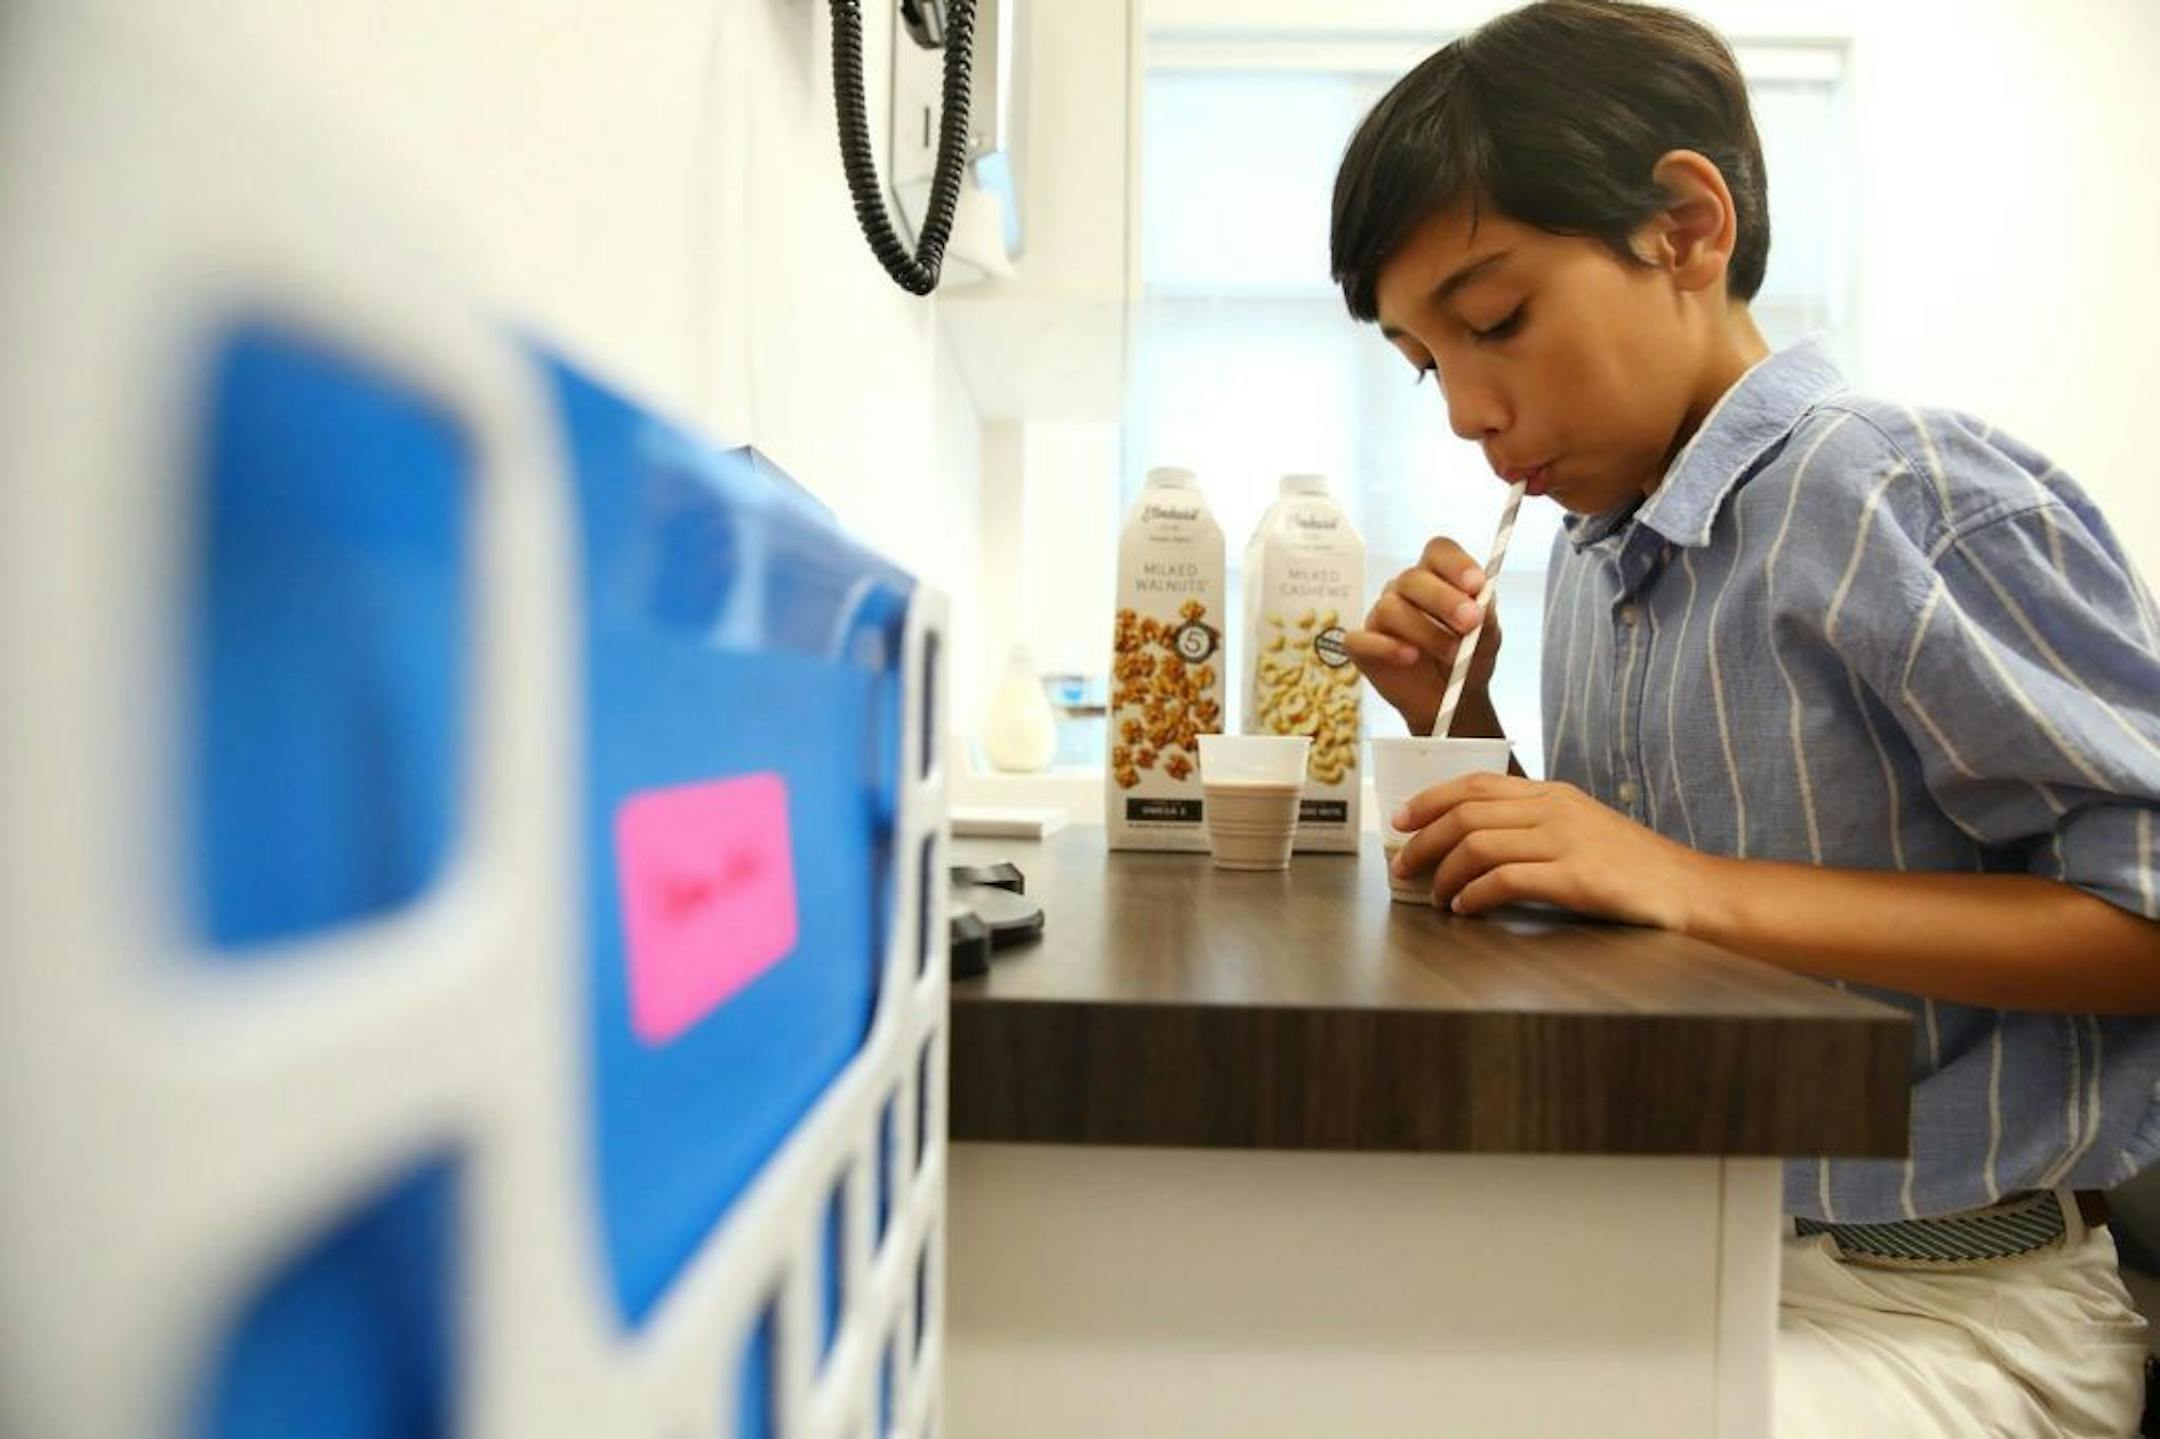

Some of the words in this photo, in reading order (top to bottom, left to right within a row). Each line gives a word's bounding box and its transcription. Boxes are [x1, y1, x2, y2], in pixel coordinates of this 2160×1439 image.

[1143, 563, 1198, 577] MILKED
[1288, 568, 1340, 583] MILKED
[1135, 579, 1205, 593] WALNUTS
[1279, 583, 1350, 598] CASHEWS
